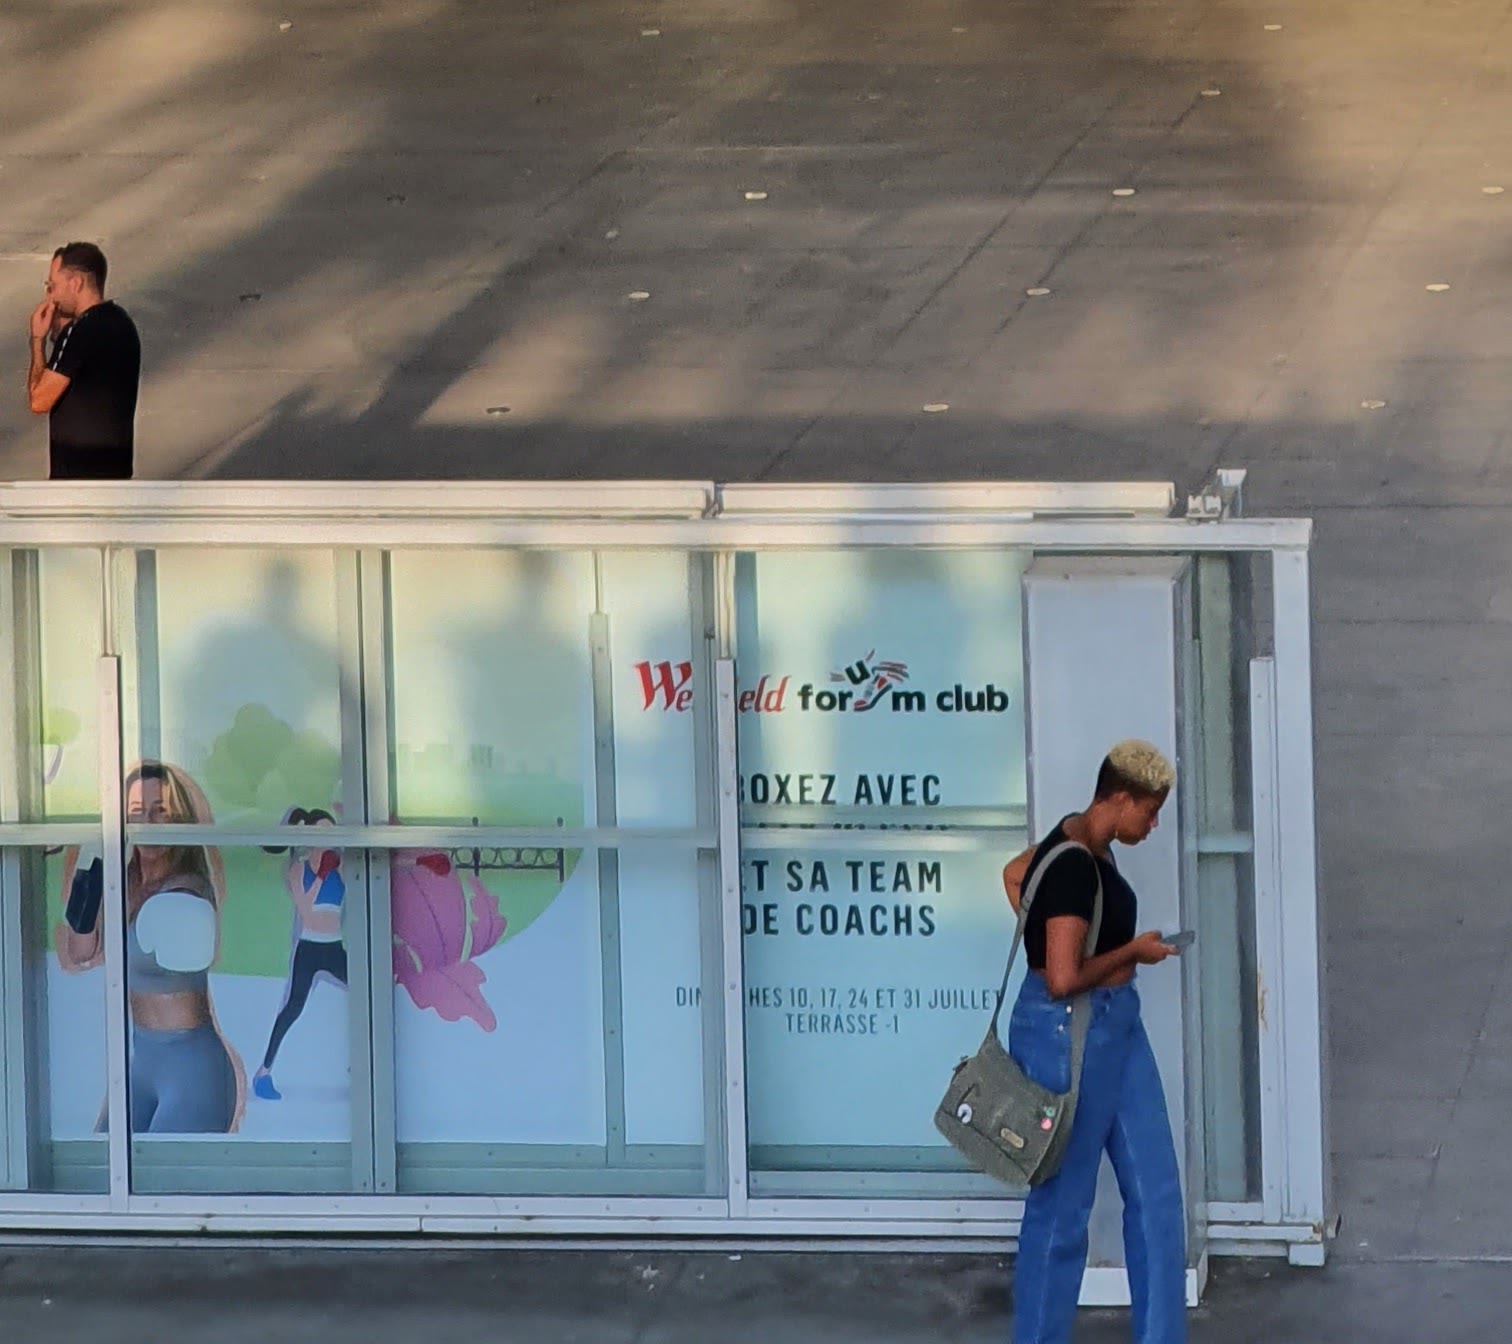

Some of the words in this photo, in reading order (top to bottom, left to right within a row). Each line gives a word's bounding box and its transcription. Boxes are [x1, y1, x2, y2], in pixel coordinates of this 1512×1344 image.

[936, 683, 1009, 713] club
[854, 773, 941, 807] AVEC
[786, 859, 830, 893] SA
[845, 859, 942, 894] TEAM
[796, 903, 936, 937] COACHS
[790, 987, 813, 1010] 10,
[821, 987, 842, 1010] 17,
[848, 987, 868, 1009] 24
[875, 988, 897, 1009] ET
[904, 988, 920, 1009] 31
[786, 1013, 878, 1035] TERRASSE
[885, 1014, 899, 1034] -1
